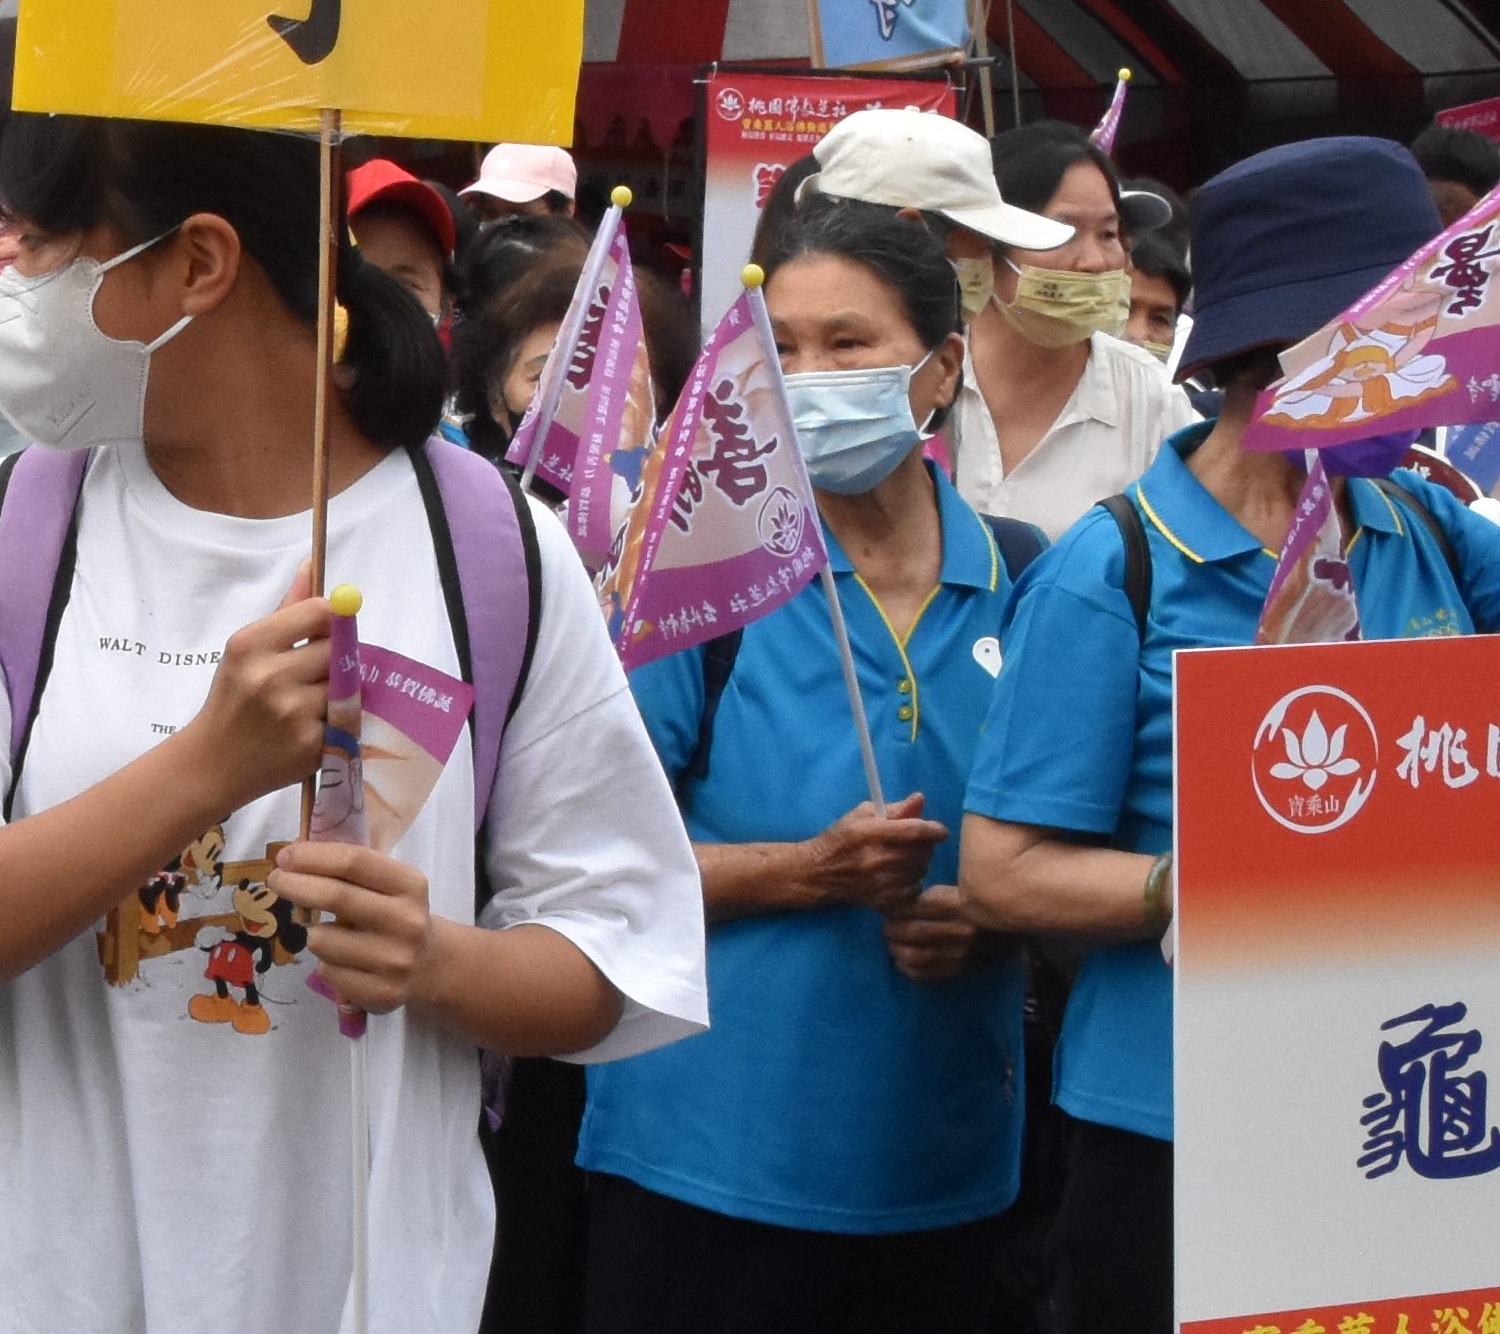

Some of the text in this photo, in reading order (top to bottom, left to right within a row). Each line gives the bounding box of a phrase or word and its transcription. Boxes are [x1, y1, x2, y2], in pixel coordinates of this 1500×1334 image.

[99, 636, 147, 656] WALT
[1288, 792, 1342, 819] 寶乘山
